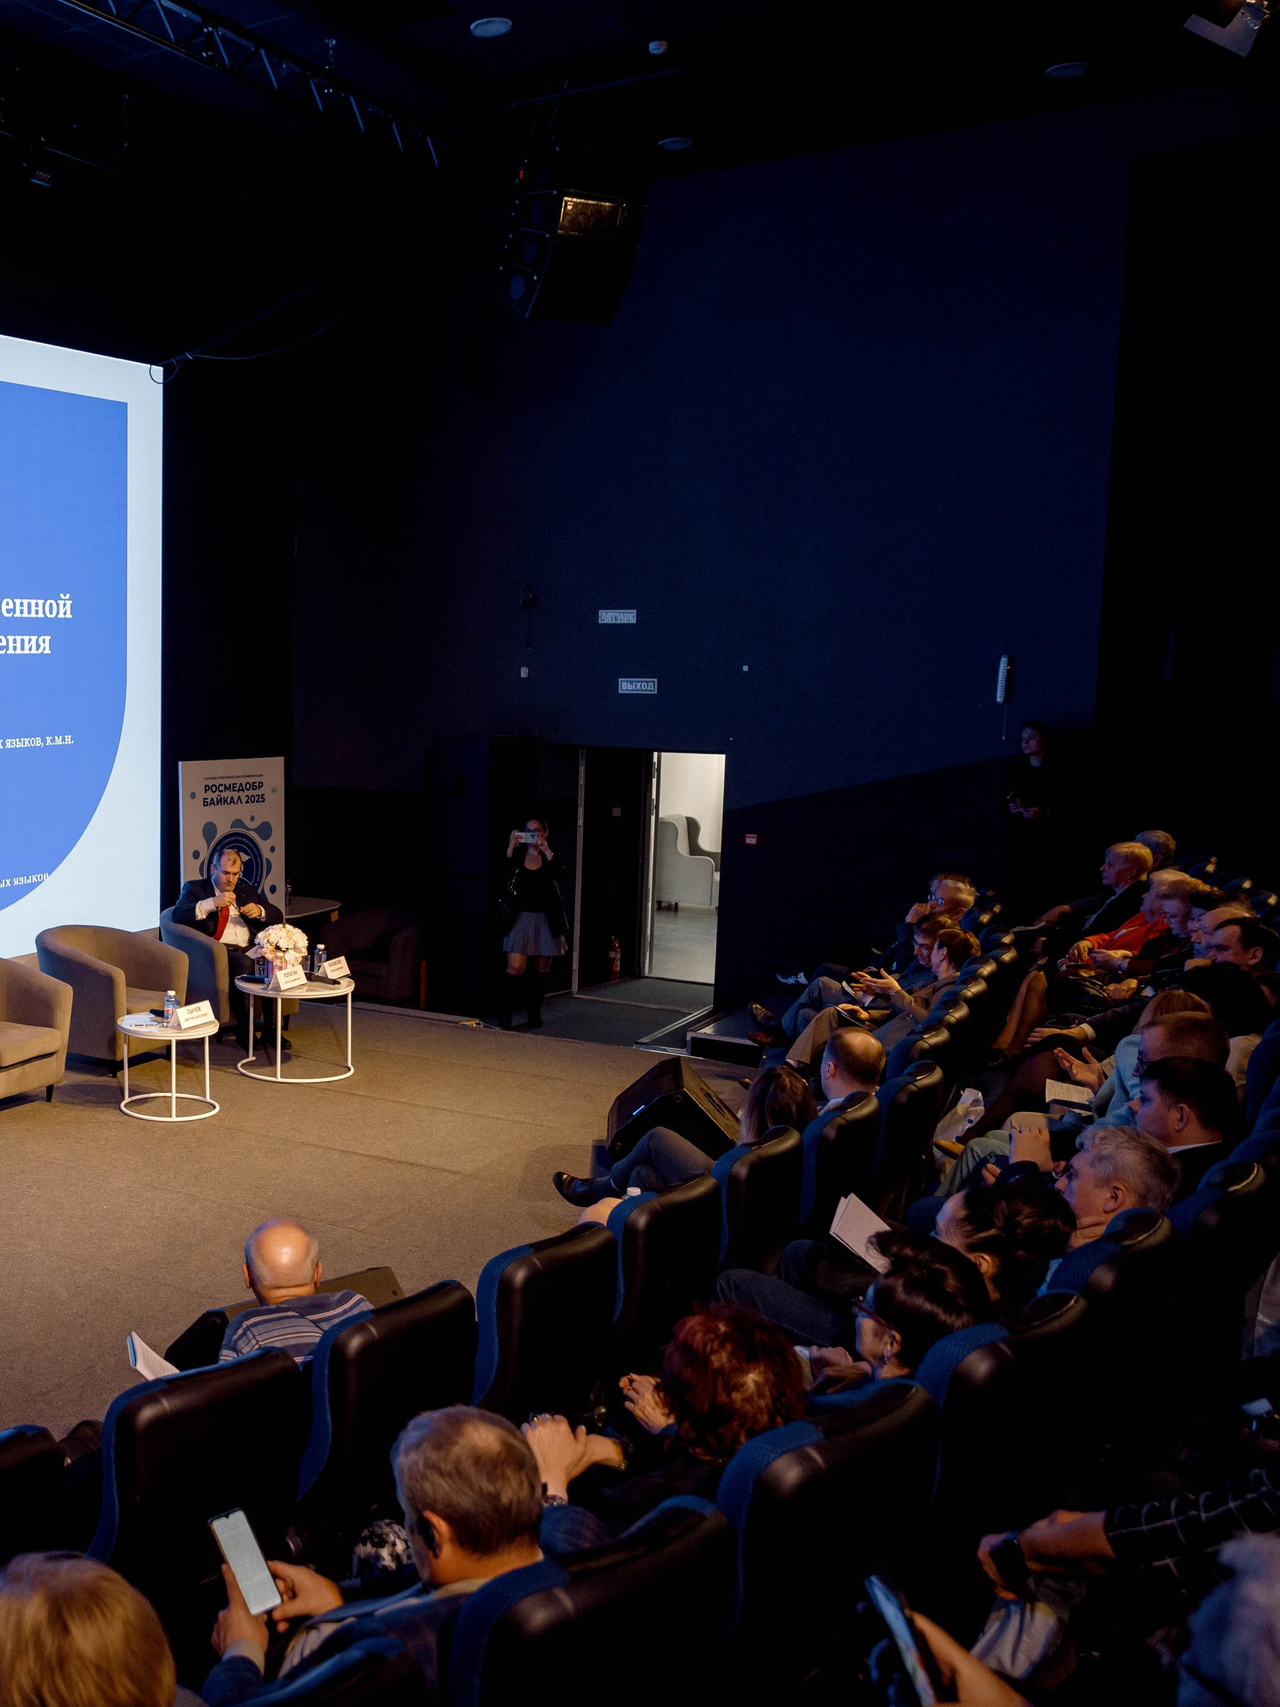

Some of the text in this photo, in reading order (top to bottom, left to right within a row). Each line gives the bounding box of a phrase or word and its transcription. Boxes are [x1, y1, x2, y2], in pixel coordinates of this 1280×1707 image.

[621, 681, 655, 691] ВЫХОД
[4, 736, 45, 749] языков,
[45, 734, 74, 746] к.м.н.
[204, 781, 264, 794] РОСМЕДОБР
[202, 793, 266, 807] БАЙКАЛ 2025
